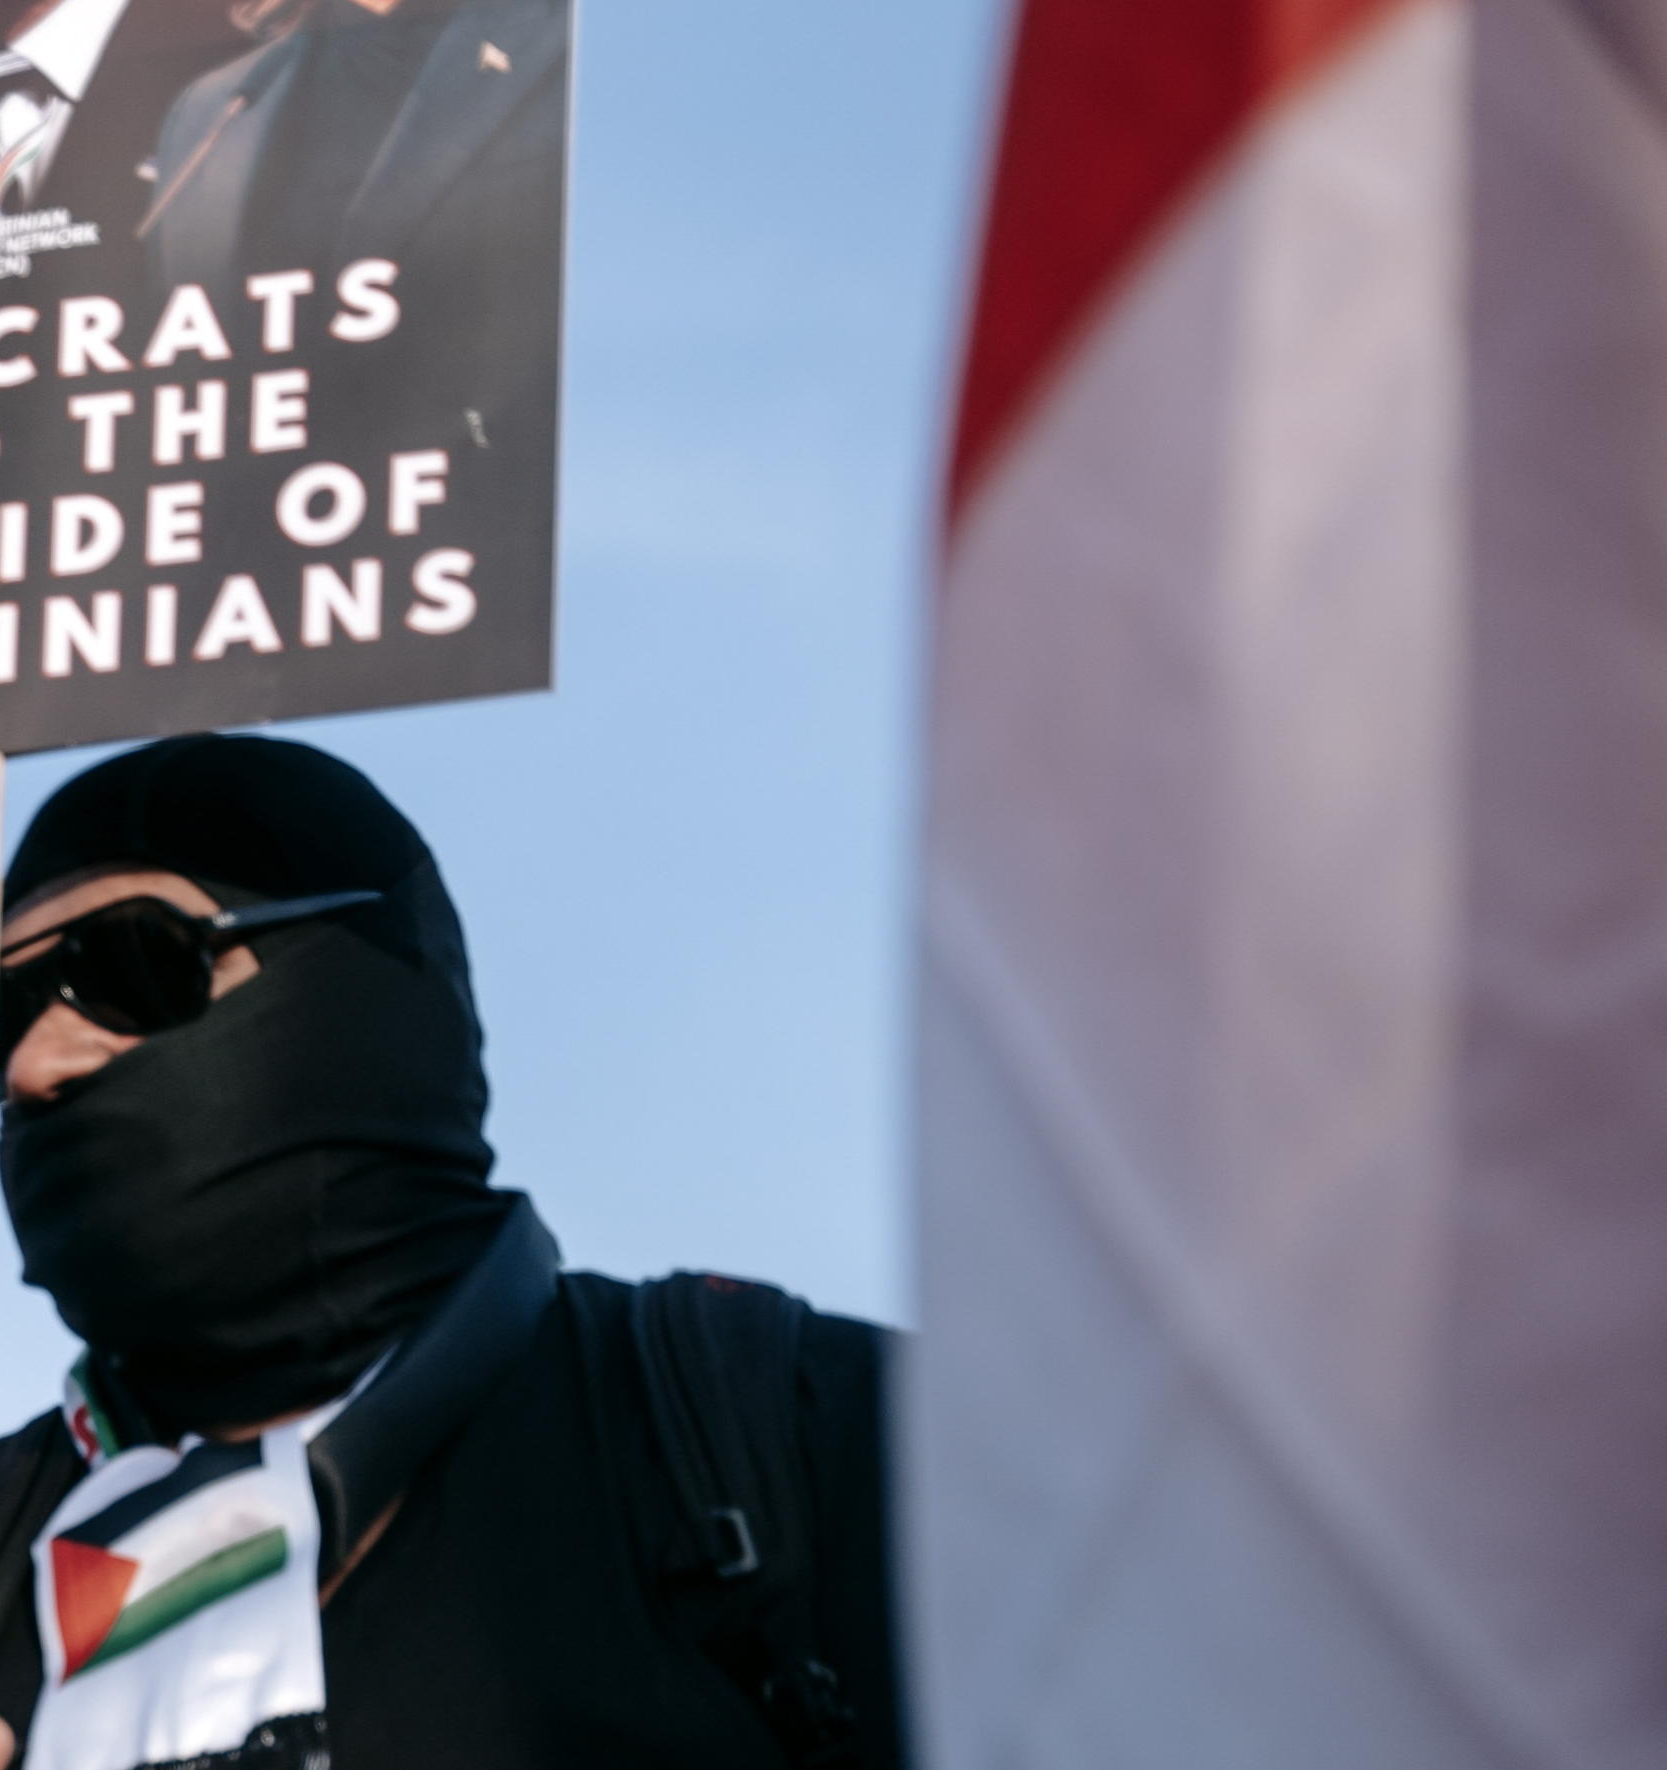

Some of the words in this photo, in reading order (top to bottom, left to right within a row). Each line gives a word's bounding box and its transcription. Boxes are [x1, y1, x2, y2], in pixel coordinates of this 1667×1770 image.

[7, 223, 100, 252] NETWORK
[67, 368, 310, 474] THE
[274, 449, 449, 567] OF
